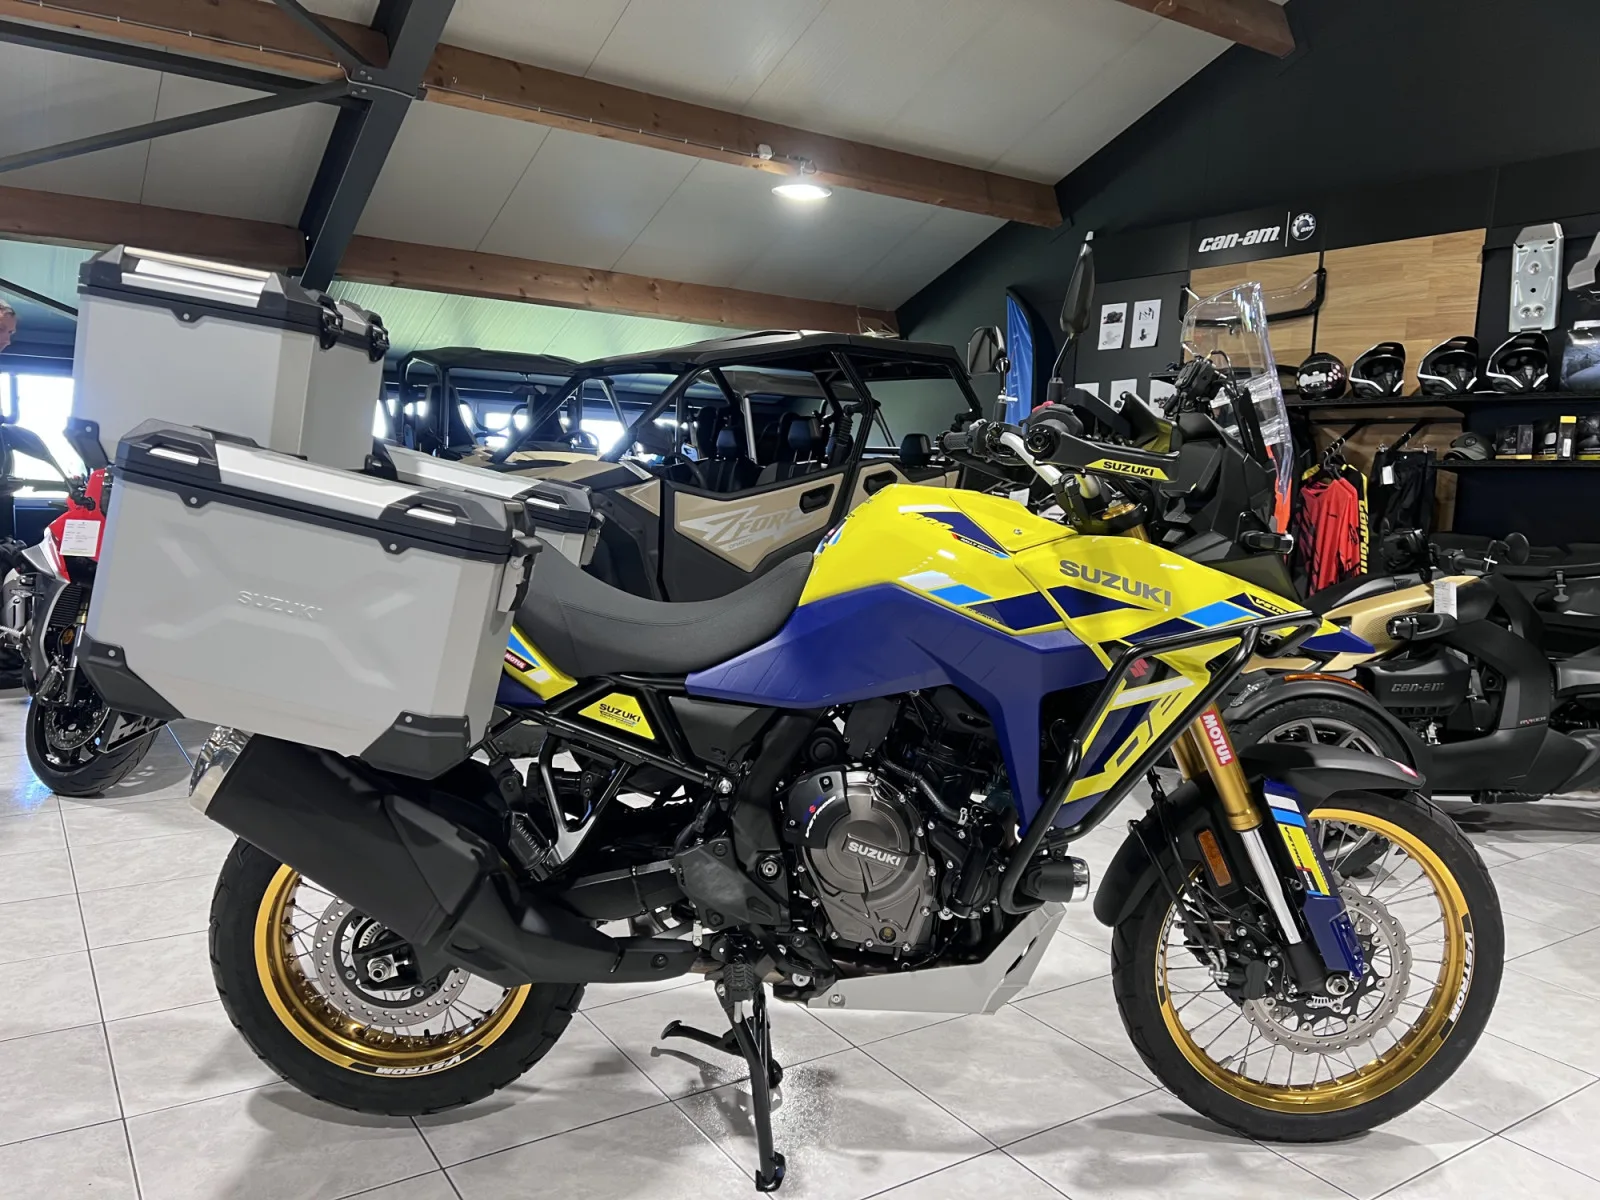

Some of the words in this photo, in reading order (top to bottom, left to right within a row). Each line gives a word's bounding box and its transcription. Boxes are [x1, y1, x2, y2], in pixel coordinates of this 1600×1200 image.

[1198, 226, 1280, 252] can-am
[1103, 461, 1155, 477] SUZUKI
[1059, 559, 1172, 607] SUZUKI
[238, 590, 323, 619] SUZUKI
[504, 652, 527, 669] MOTUL
[599, 703, 641, 722] SUZUKI
[1202, 714, 1233, 764] MOTUL
[848, 841, 901, 866] SUZUKI
[375, 1055, 461, 1075] V-STROM
